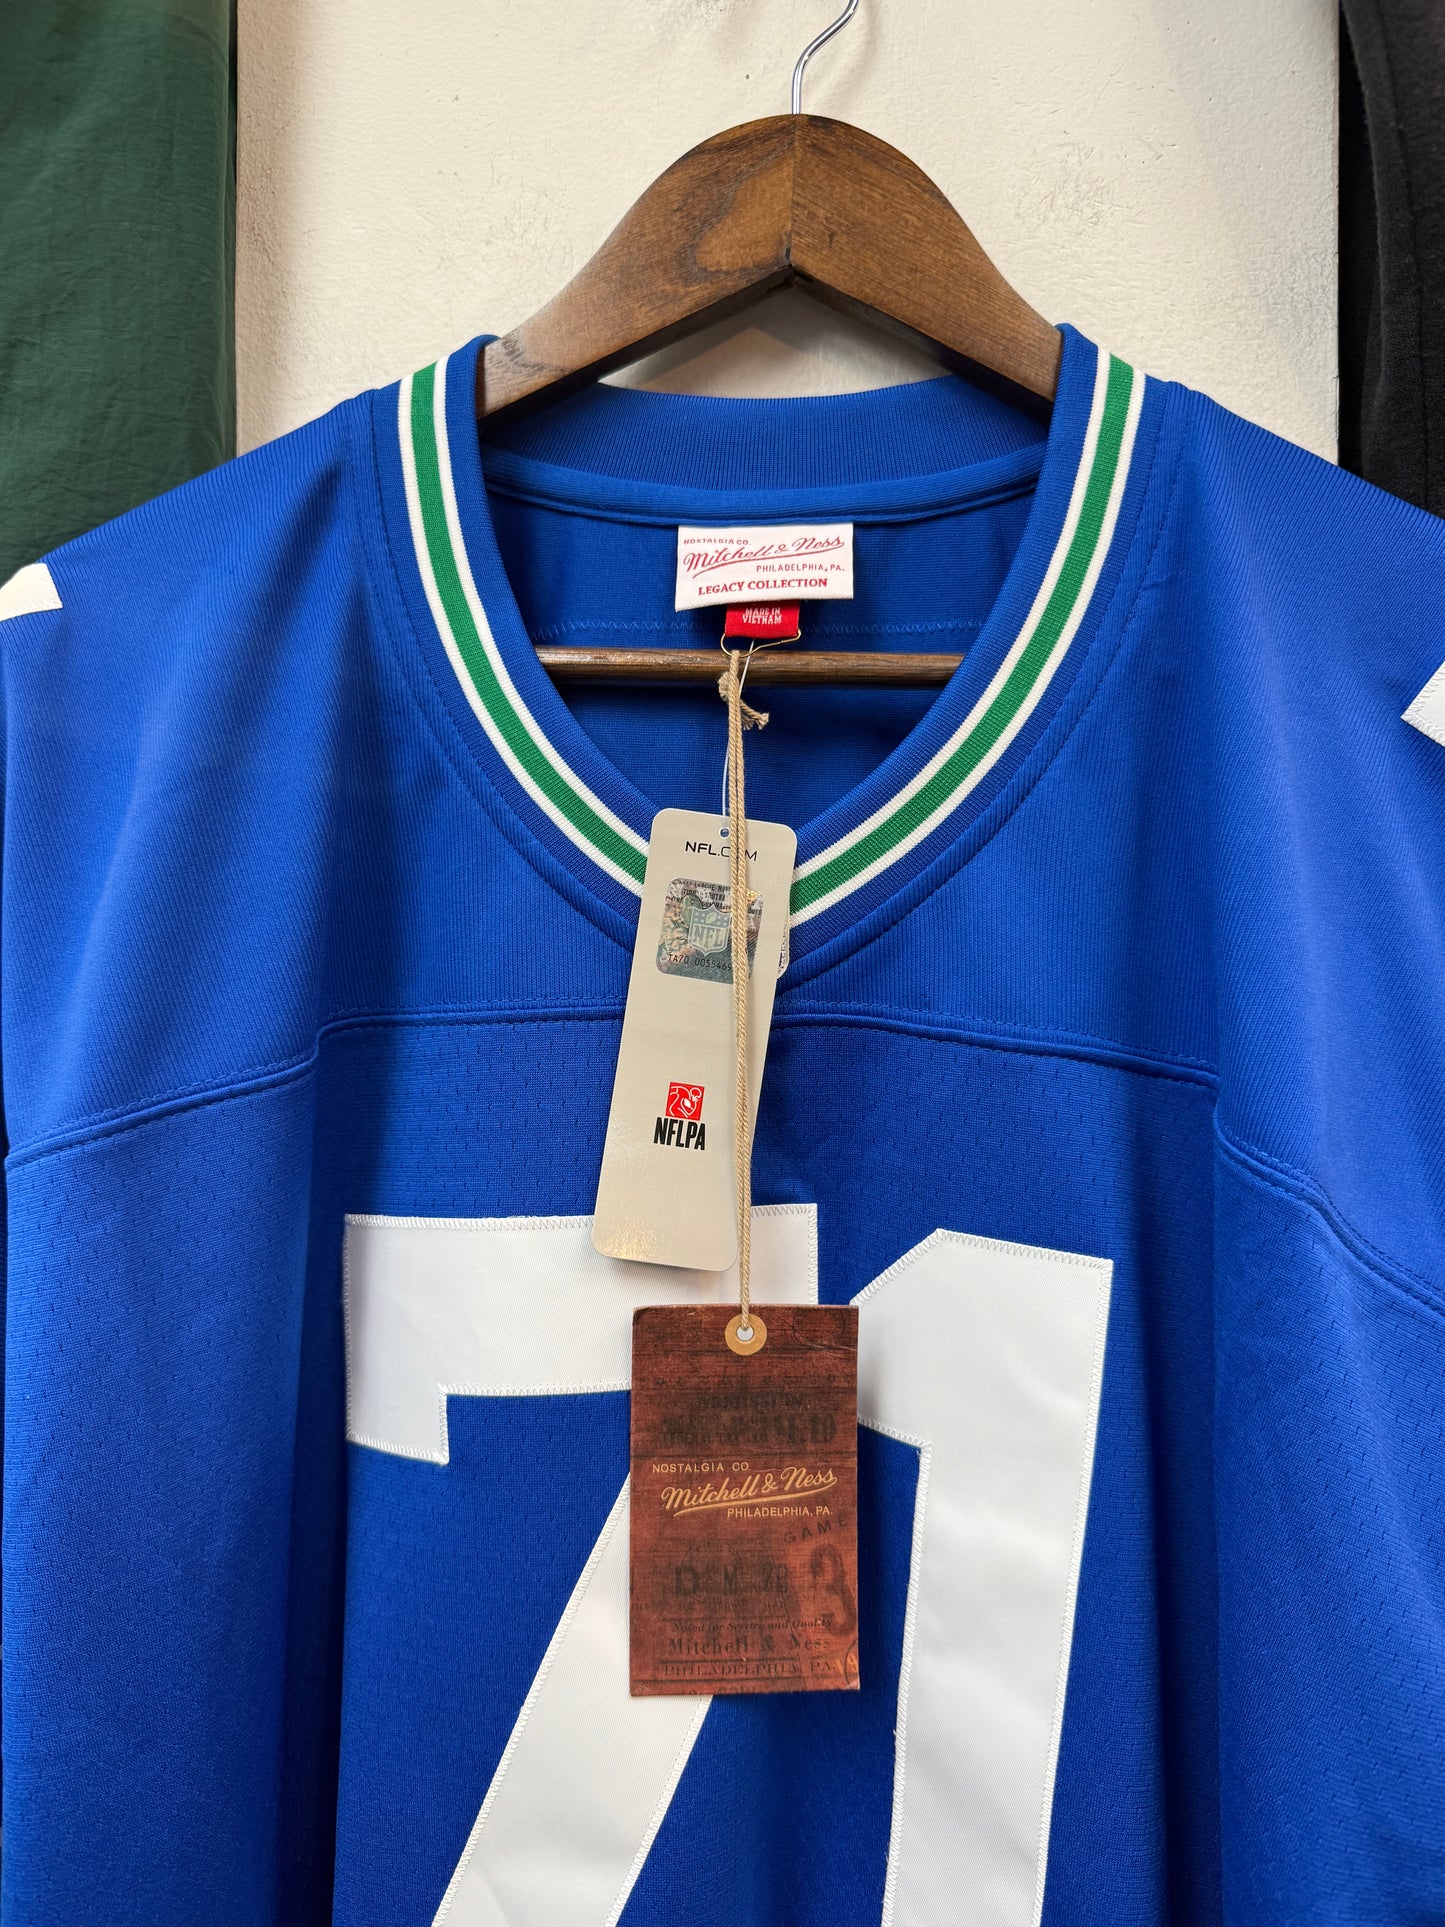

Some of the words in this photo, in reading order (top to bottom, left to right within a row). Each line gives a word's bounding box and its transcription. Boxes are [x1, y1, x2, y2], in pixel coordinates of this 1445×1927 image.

[683, 544, 775, 573] Mitchell
[774, 543, 788, 554] &
[791, 536, 845, 552] Ness
[756, 563, 829, 573] PHILADELPHIA,
[830, 563, 846, 572] PA.
[698, 581, 745, 596] LEGACY
[747, 578, 828, 592] COLLECTION
[742, 614, 782, 625] VIETNAM
[745, 607, 770, 617] MADE
[771, 607, 781, 616] IN
[685, 841, 758, 862] NFL.CM
[691, 925, 724, 949] NFL
[653, 1117, 706, 1151] NFLPA
[652, 1462, 724, 1473] NOSTALGIA
[661, 1474, 761, 1510] Mitchell
[761, 1473, 778, 1493] &
[780, 1466, 838, 1492] Ness
[727, 1506, 814, 1518] PHILADELPHIA,
[815, 1505, 834, 1516] PA.
[783, 1515, 848, 1545] GAME
[343, 1202, 1113, 1927] 71
[766, 1617, 790, 1630] and
[669, 1636, 749, 1657] Mitchell
